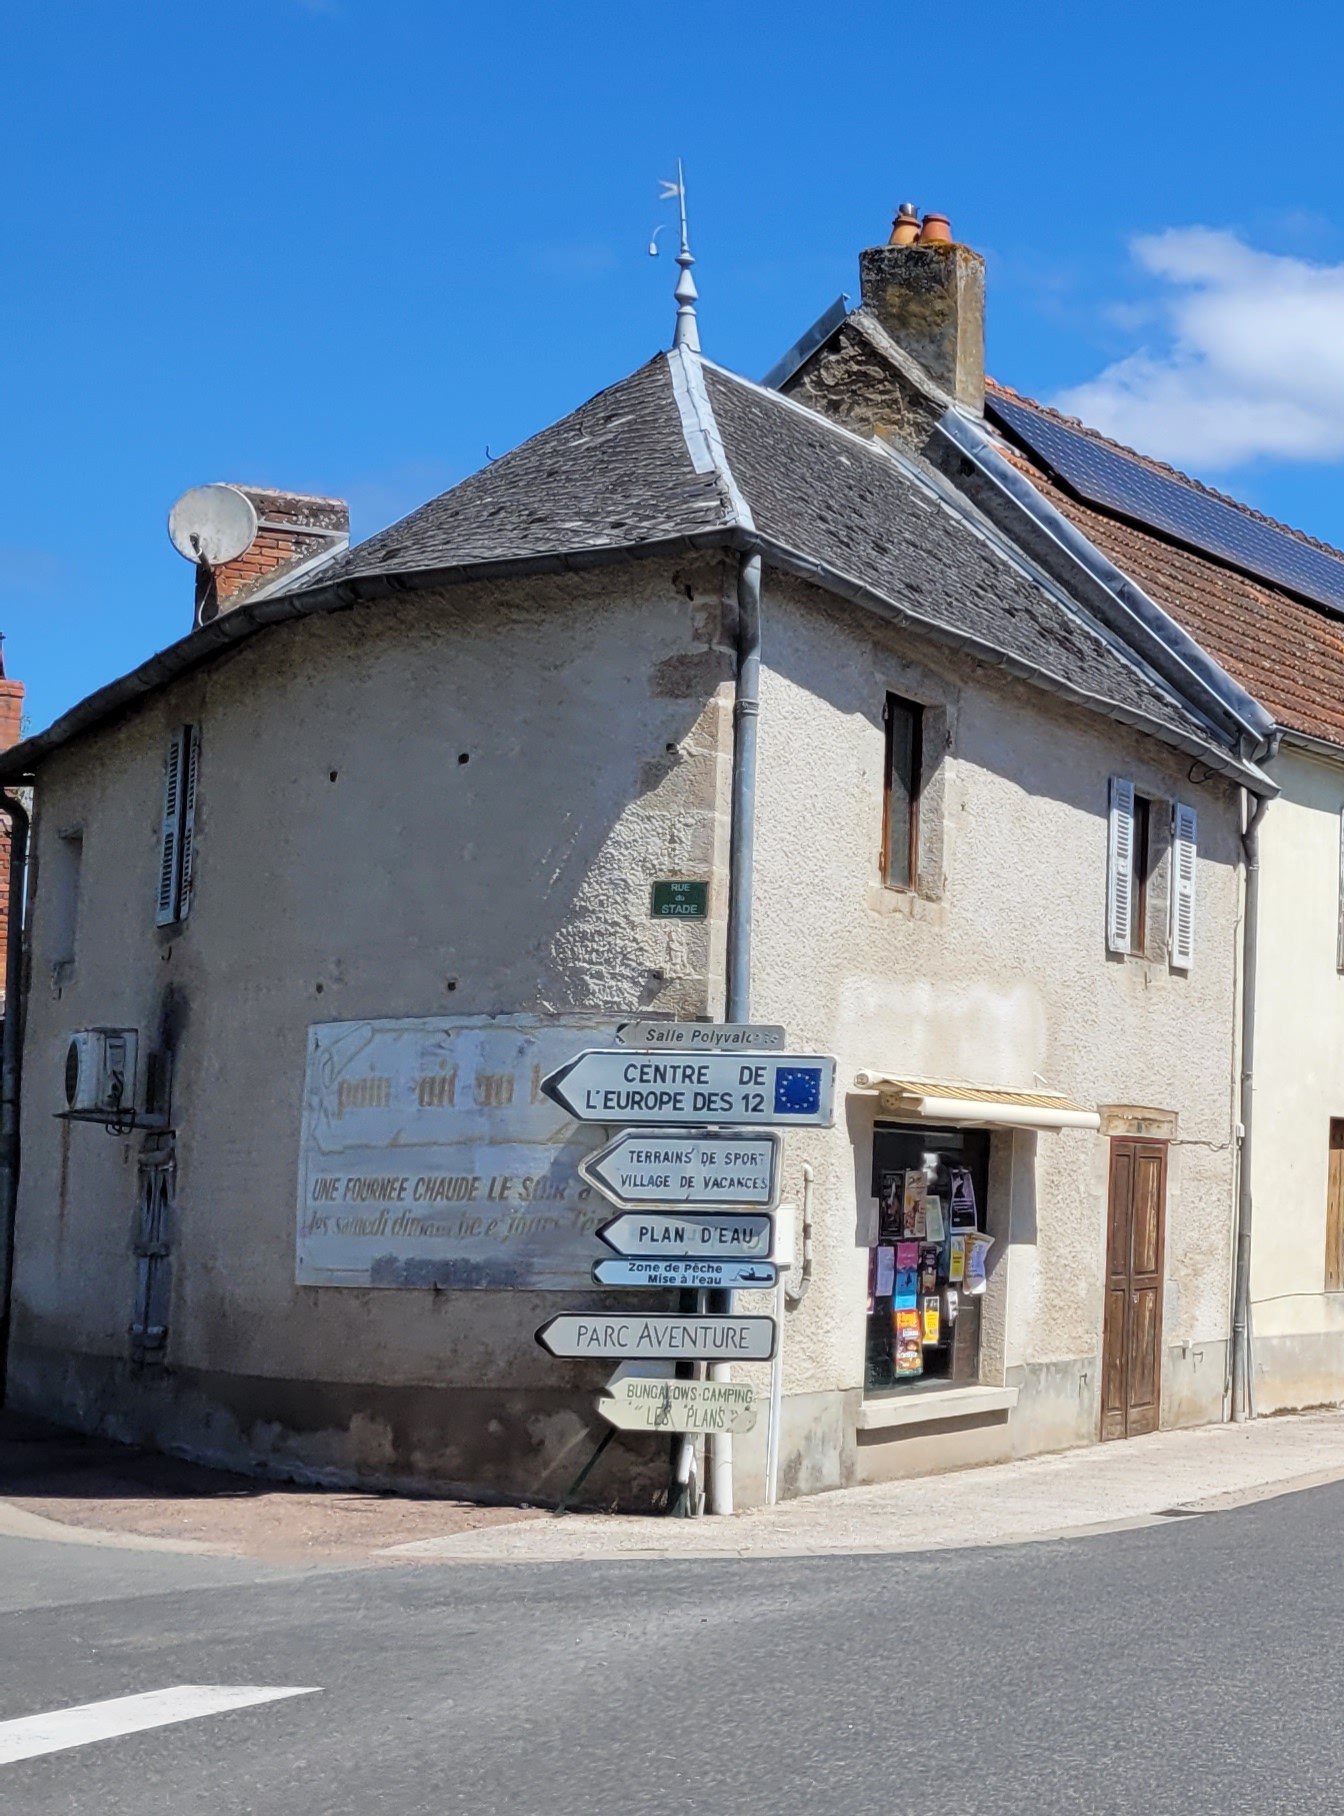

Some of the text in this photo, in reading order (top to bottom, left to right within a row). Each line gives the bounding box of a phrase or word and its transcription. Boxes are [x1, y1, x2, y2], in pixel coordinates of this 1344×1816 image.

[671, 883, 691, 892] RUE
[661, 904, 698, 914] STADE
[646, 1029, 684, 1043] Salle
[624, 1063, 767, 1086] CENTRE DE
[586, 1089, 765, 1113] L'EUROPE DES 12
[628, 1150, 693, 1165] TERRAINS
[701, 1152, 717, 1165] DE
[312, 1177, 341, 1201] UNE
[413, 1176, 481, 1201] CHAUDE
[487, 1176, 513, 1201] LE
[620, 1174, 768, 1190] VILLAGE DE VACANCES
[639, 1226, 753, 1244] PLAN D'EAU
[628, 1262, 722, 1273] Zone de Pêche
[648, 1274, 722, 1285] Mise à l'eau
[577, 1321, 751, 1349] PARC AVENTURE
